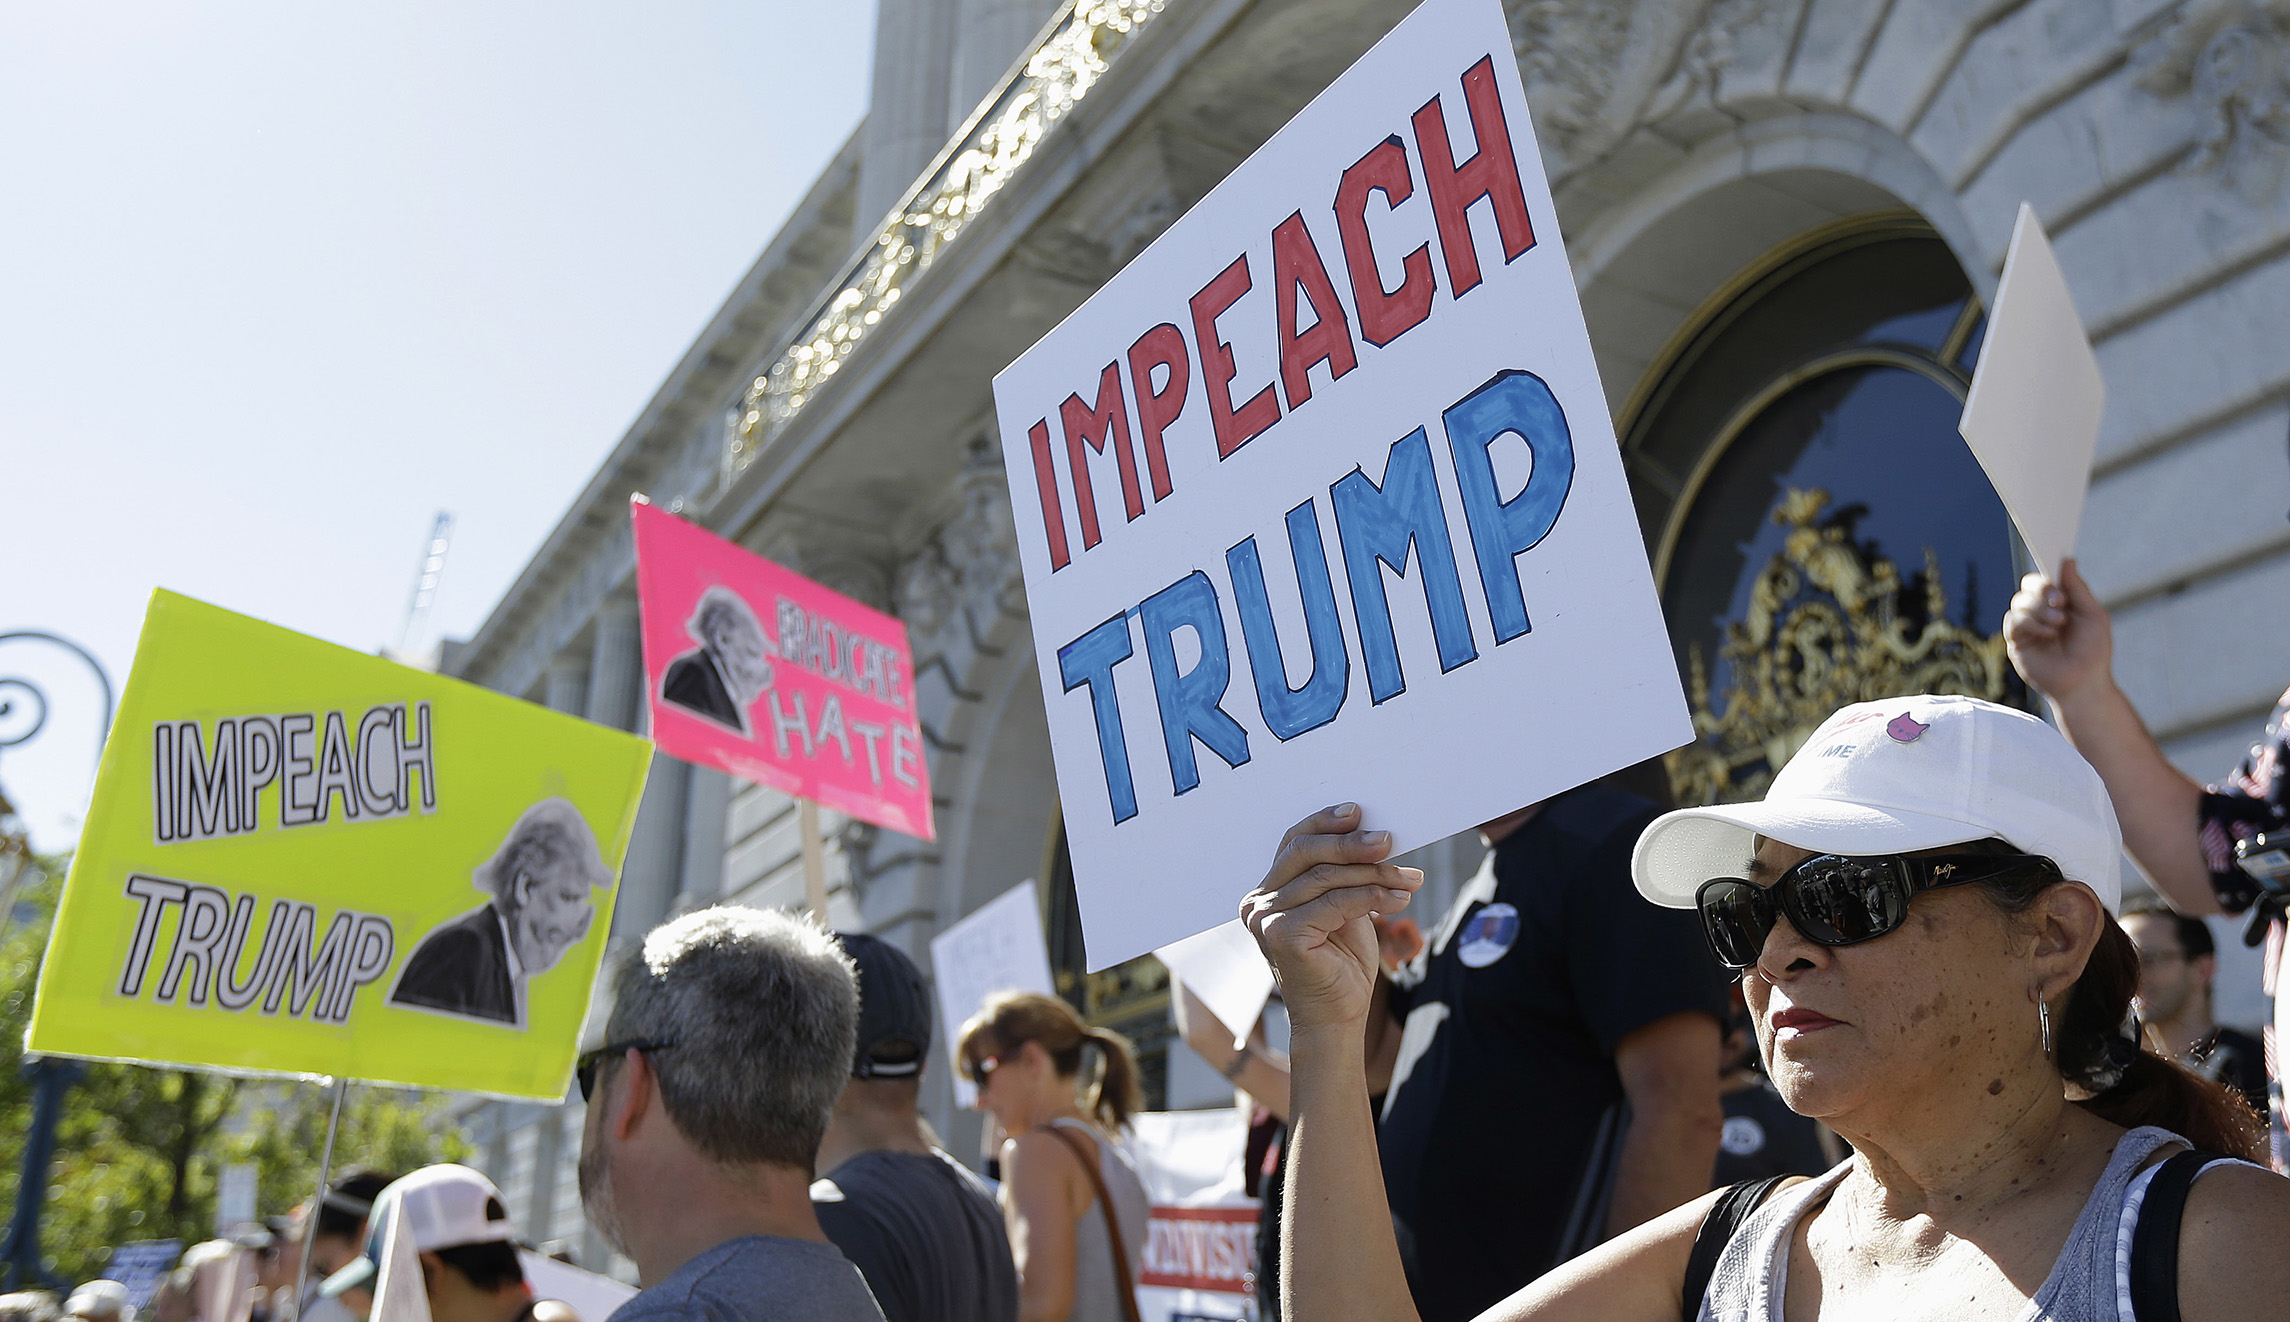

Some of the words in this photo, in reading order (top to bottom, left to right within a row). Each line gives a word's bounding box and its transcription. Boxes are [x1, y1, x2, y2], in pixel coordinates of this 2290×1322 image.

[1028, 54, 1537, 573] IMPEACH
[777, 597, 904, 705] ERADICATE
[1058, 369, 1576, 826] TRUMP
[154, 702, 437, 844] IMPEACH
[770, 692, 919, 787] HATE
[119, 876, 394, 1022] TRUMP
